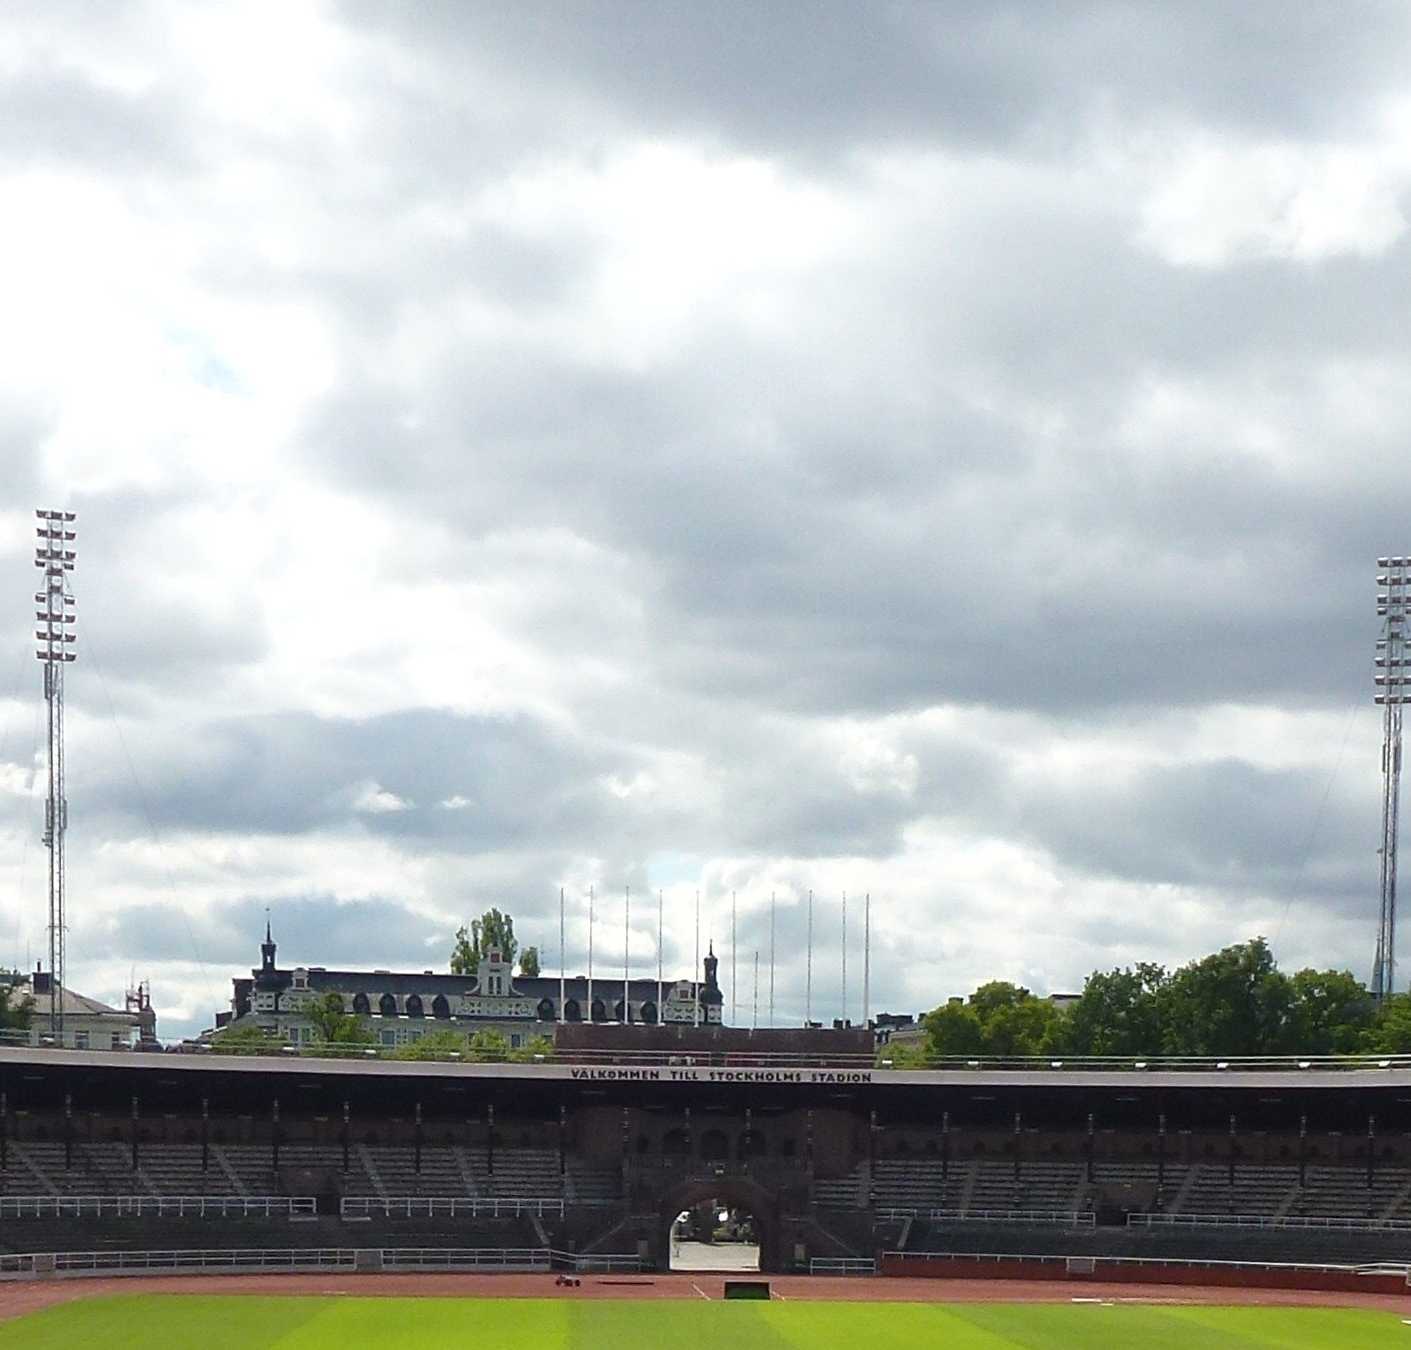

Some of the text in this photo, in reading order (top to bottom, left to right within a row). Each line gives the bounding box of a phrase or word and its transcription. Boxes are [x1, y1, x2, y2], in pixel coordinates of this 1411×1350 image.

[572, 1067, 872, 1083] VÄLKOMMEN TILL STOCKHOLMS STADION
